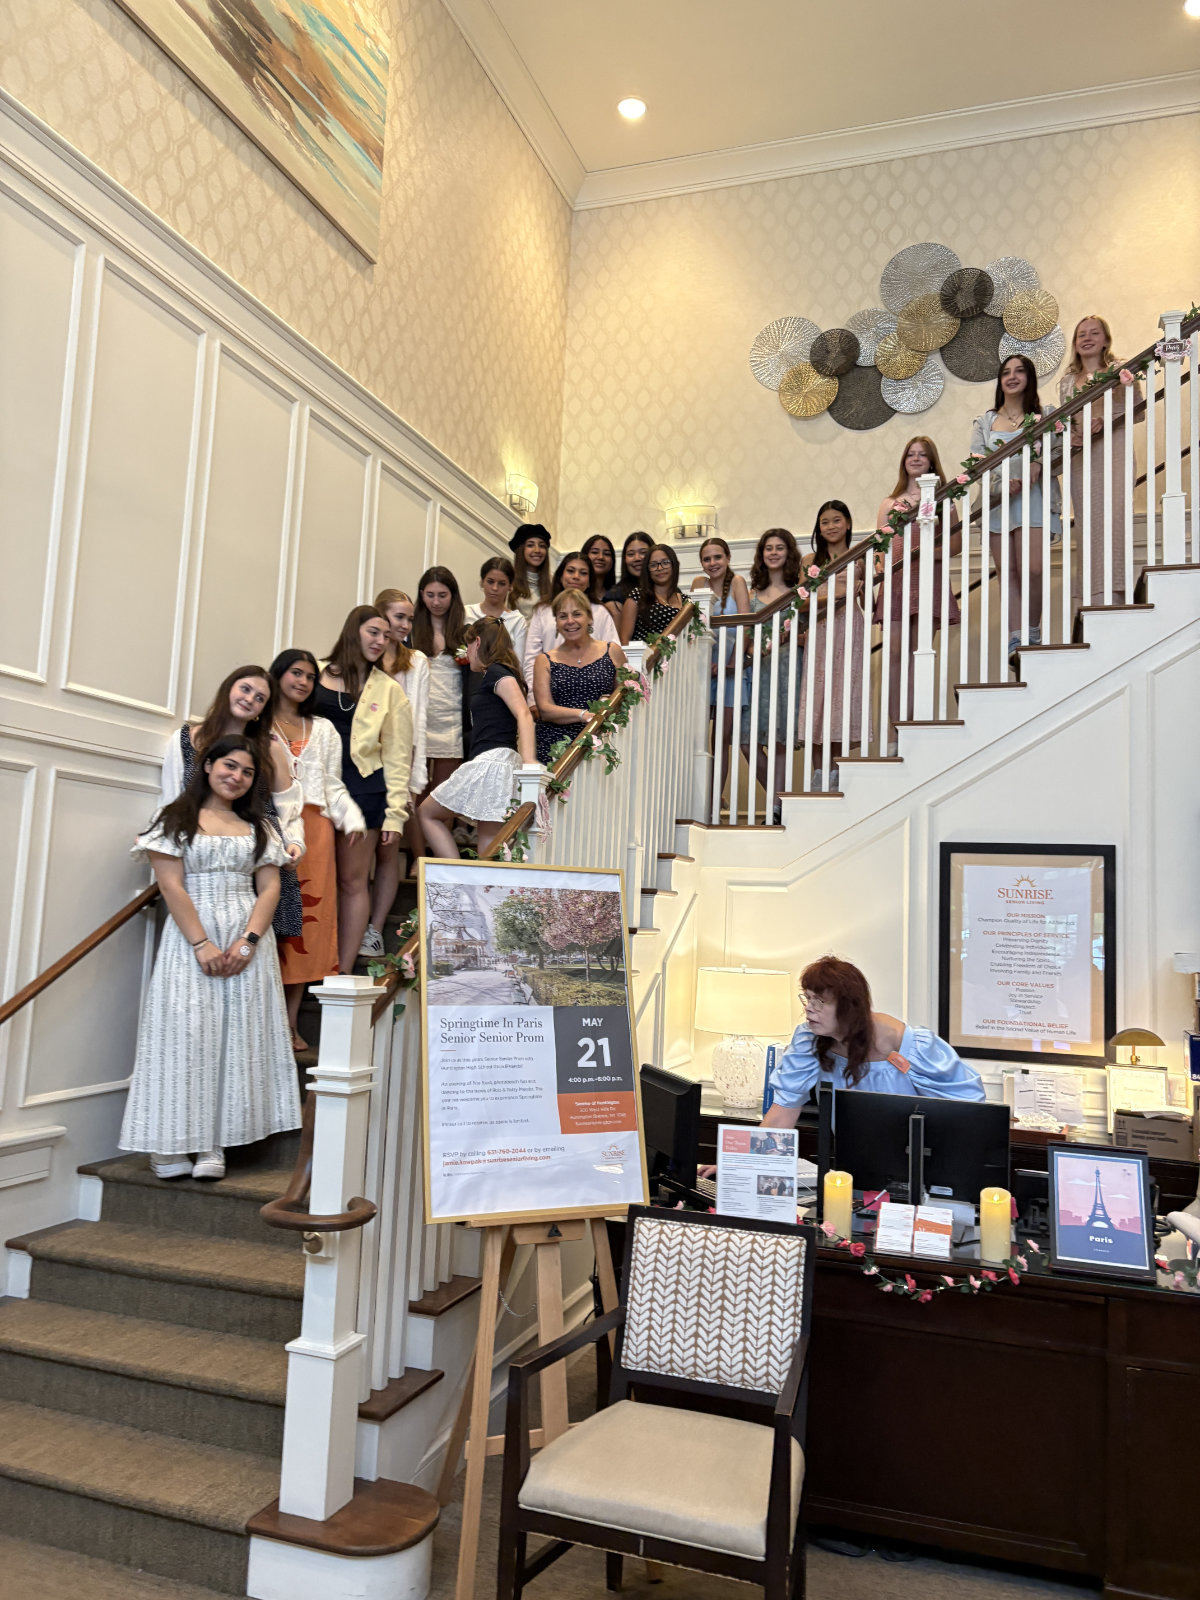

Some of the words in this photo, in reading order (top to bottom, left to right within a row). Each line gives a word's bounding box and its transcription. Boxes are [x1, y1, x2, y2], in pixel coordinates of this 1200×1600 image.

[997, 888, 1053, 899] SUNRISE
[440, 1018, 500, 1031] Springtime
[503, 1018, 513, 1028] In
[517, 1018, 542, 1028] Paris
[582, 1018, 603, 1026] MAY
[441, 1033, 476, 1043] Senior
[480, 1032, 513, 1042] Senior
[516, 1032, 544, 1042] Prom
[578, 1037, 611, 1067] 21
